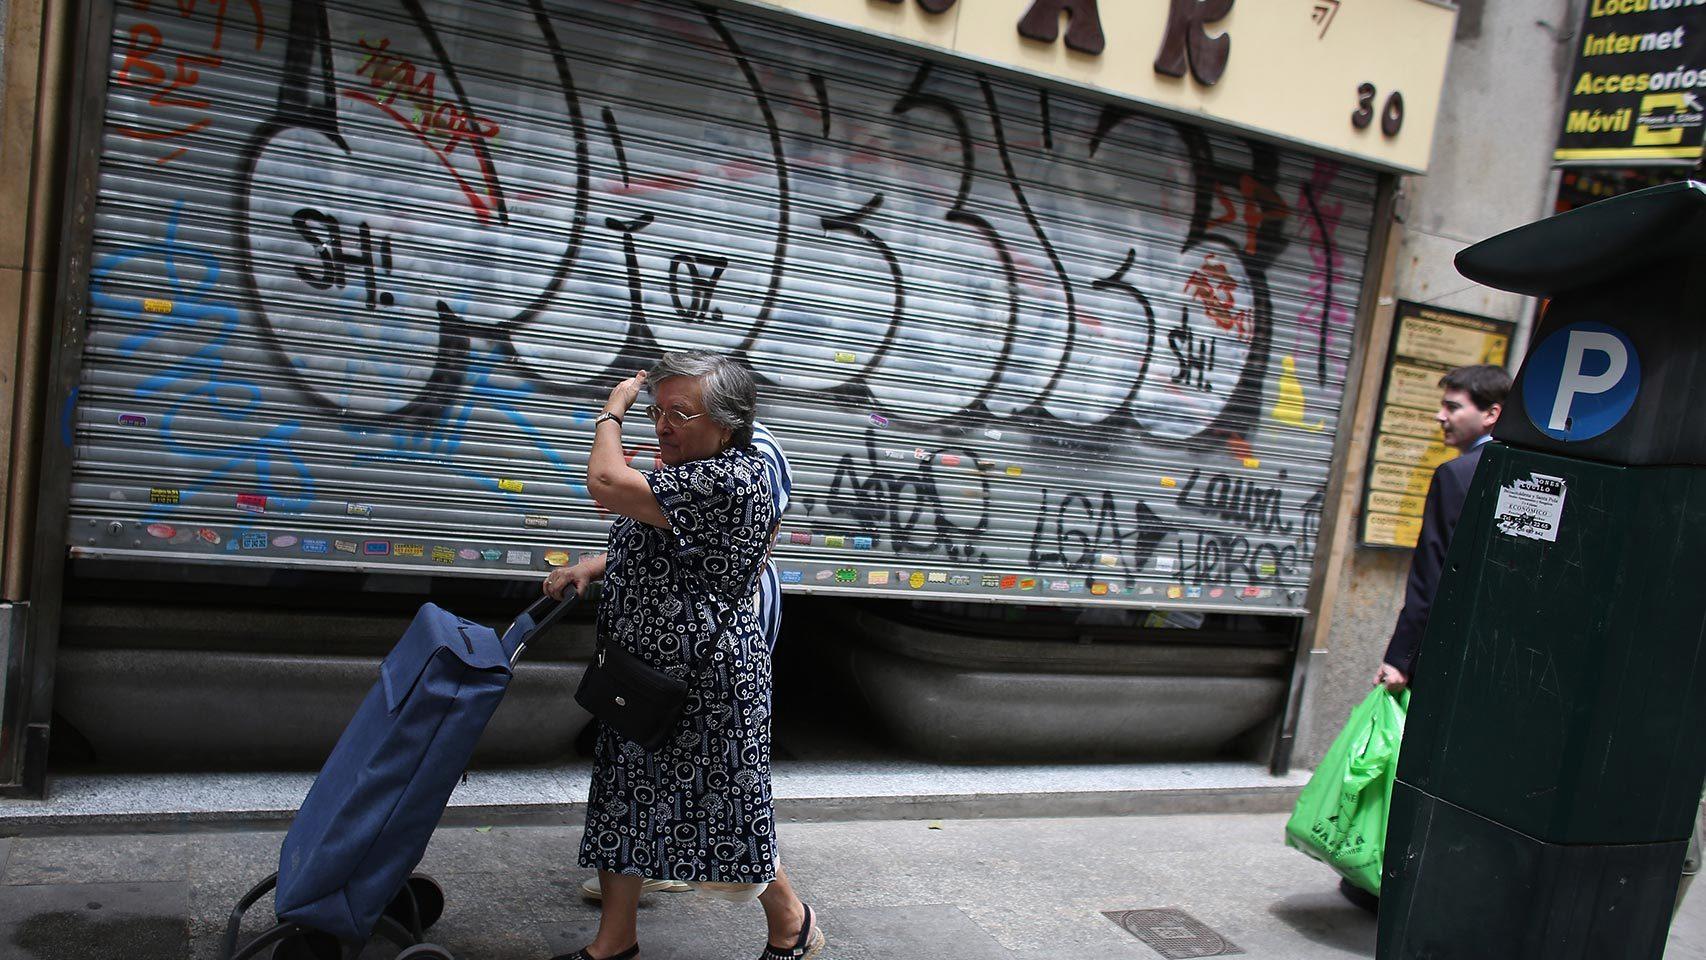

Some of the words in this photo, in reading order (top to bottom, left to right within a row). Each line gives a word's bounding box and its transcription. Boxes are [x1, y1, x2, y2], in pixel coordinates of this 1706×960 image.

[1583, 25, 1685, 57] Internet
[1573, 65, 1706, 95] Accesorios
[1352, 83, 1404, 138] 30
[1565, 107, 1633, 133] Móvil
[1548, 330, 1628, 431] P
